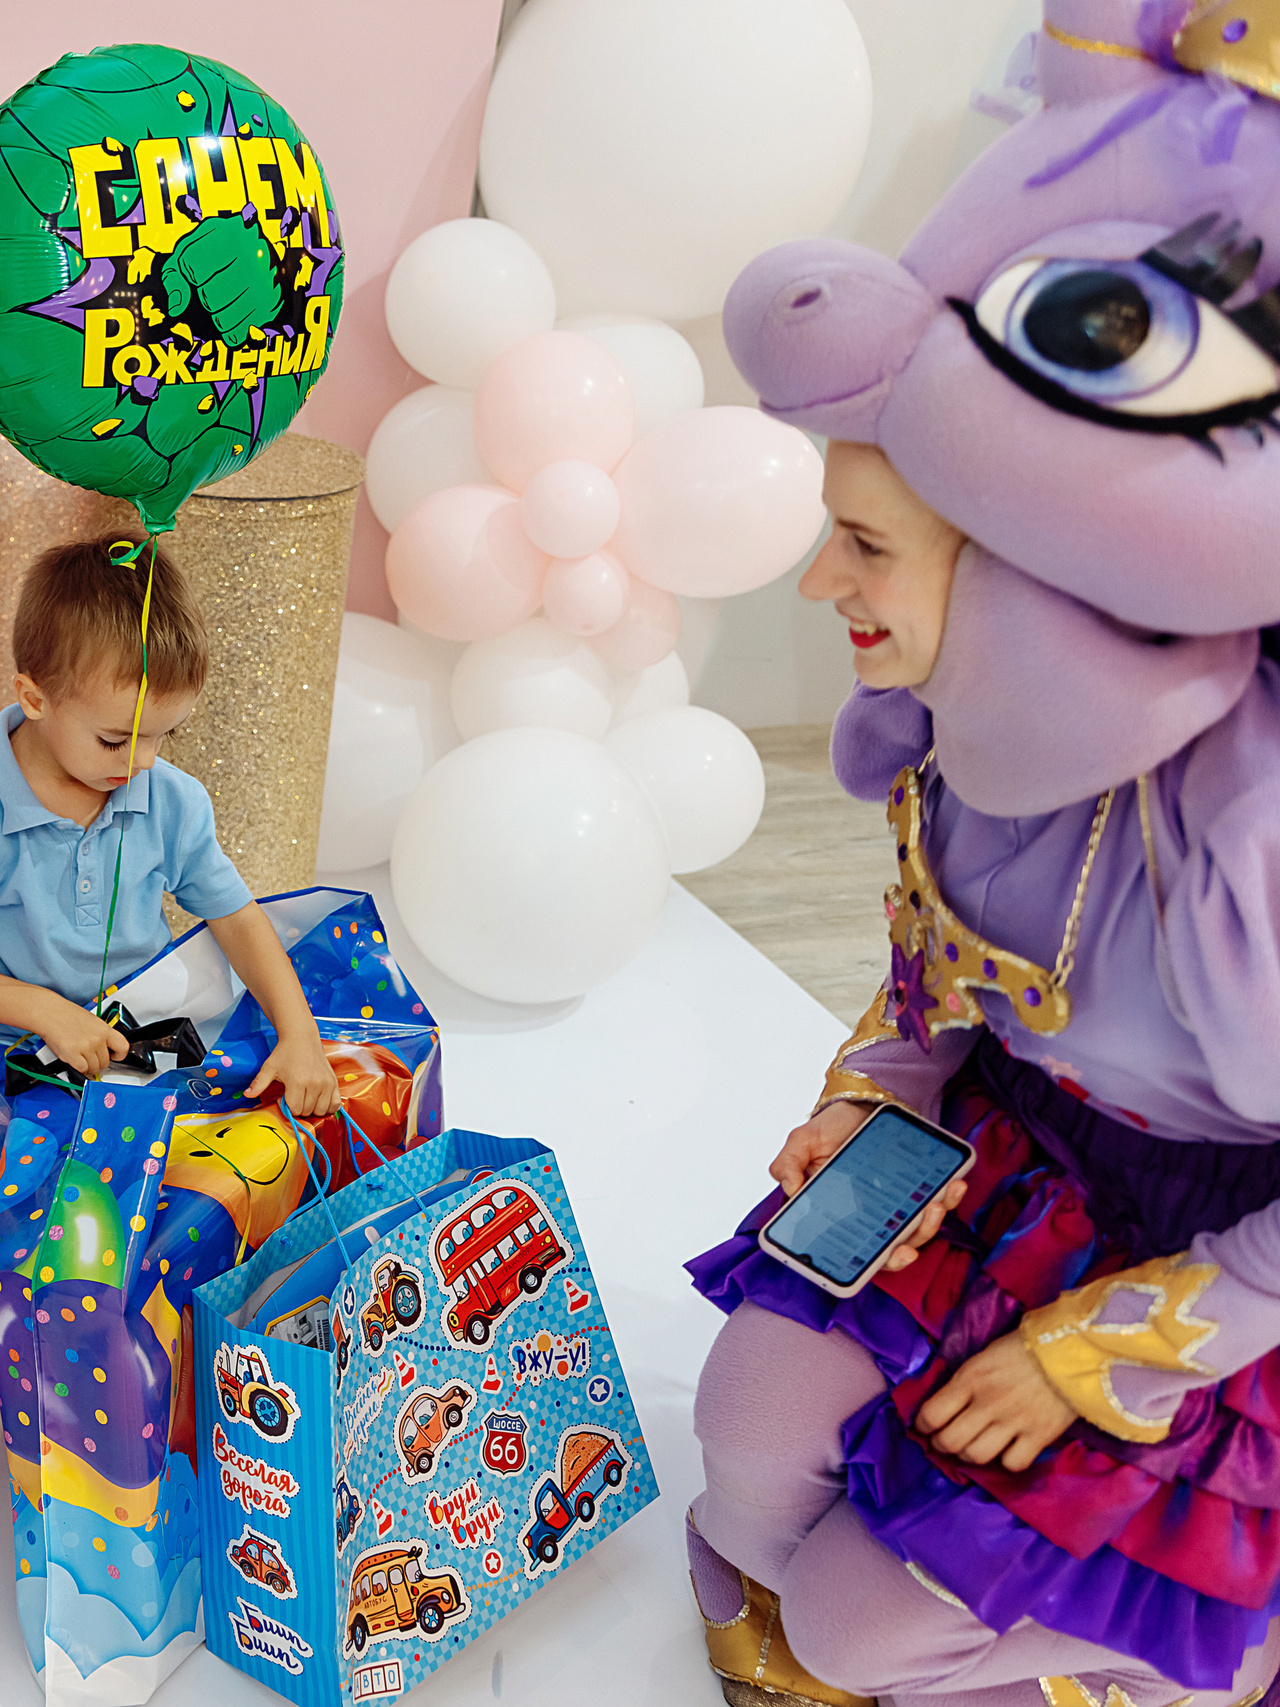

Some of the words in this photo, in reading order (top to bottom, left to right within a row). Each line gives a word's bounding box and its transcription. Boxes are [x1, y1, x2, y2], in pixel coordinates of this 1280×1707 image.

[69, 138, 133, 259] С
[501, 1244, 534, 1276] ТРАНСПОРТ
[493, 1418, 522, 1431] ШОССЕ
[214, 1426, 296, 1493] Веселая
[490, 1436, 518, 1465] 66
[222, 1469, 287, 1514] дорога
[363, 1595, 387, 1610] АВТОБУС
[355, 1669, 396, 1692] АВТО
